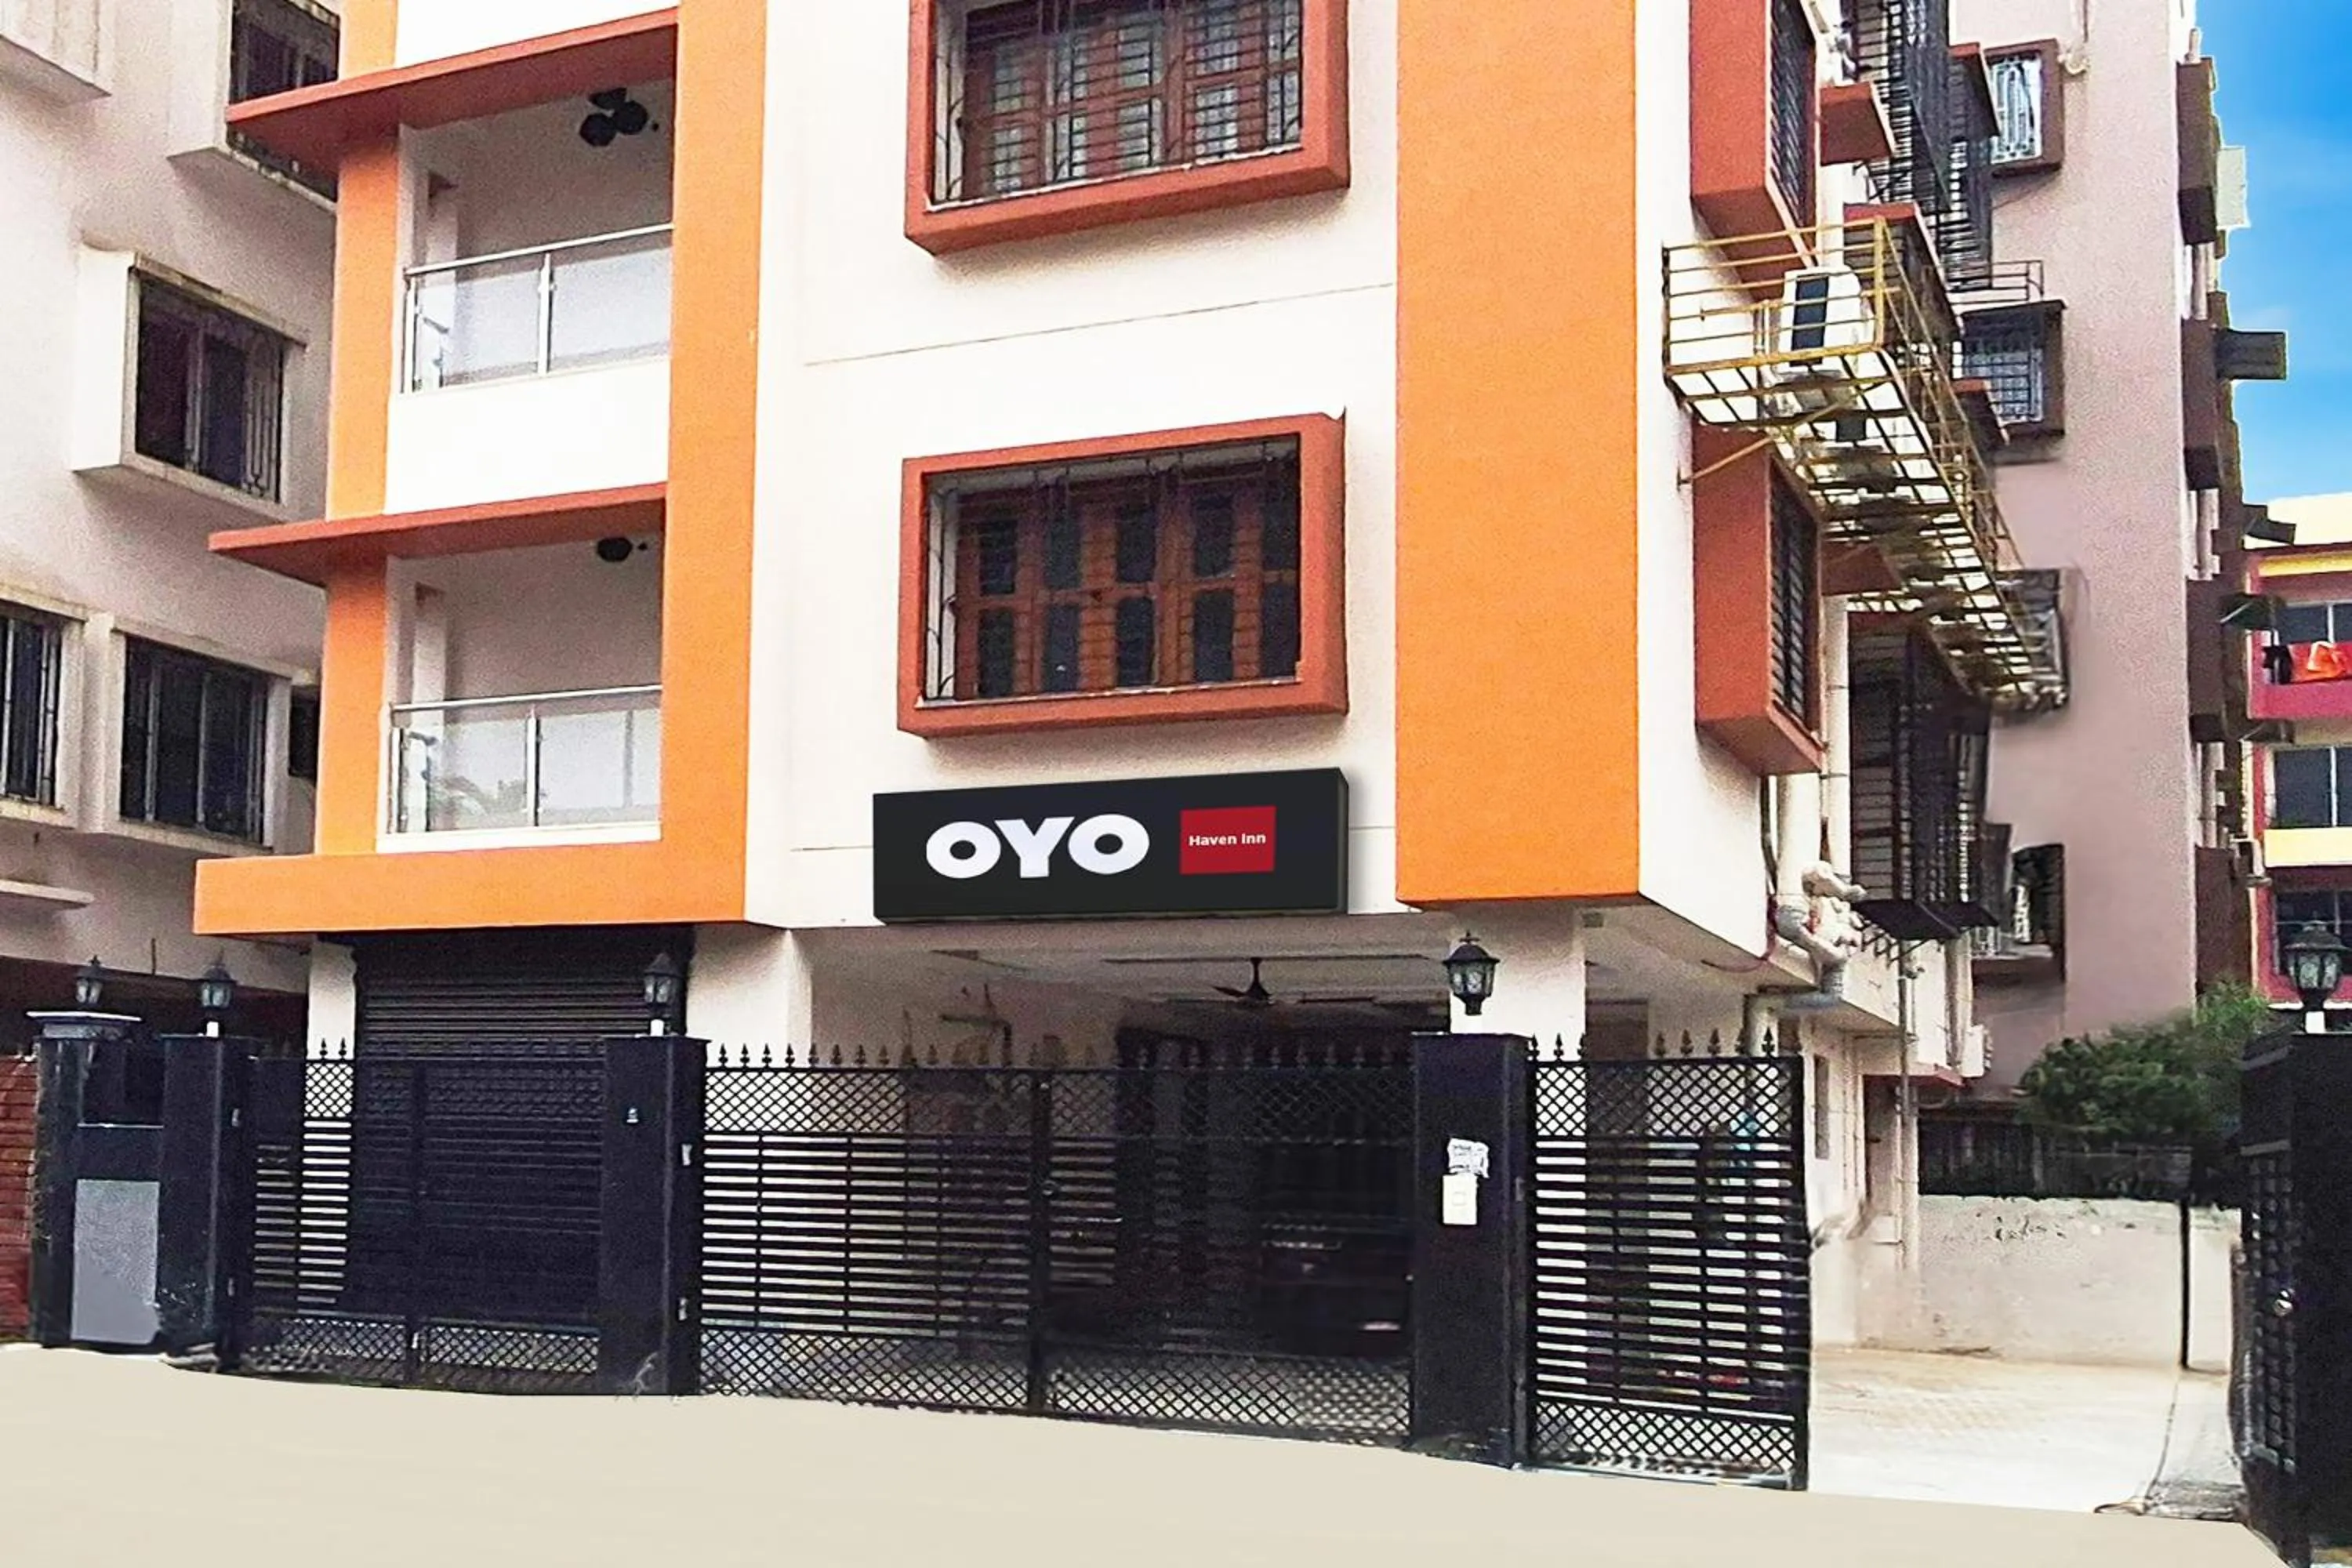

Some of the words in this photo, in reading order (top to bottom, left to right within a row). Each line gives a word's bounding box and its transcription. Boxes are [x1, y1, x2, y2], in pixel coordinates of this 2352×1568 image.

[926, 814, 1150, 879] OYO
[1189, 834, 1237, 846] Haven
[1241, 833, 1266, 844] Inn
